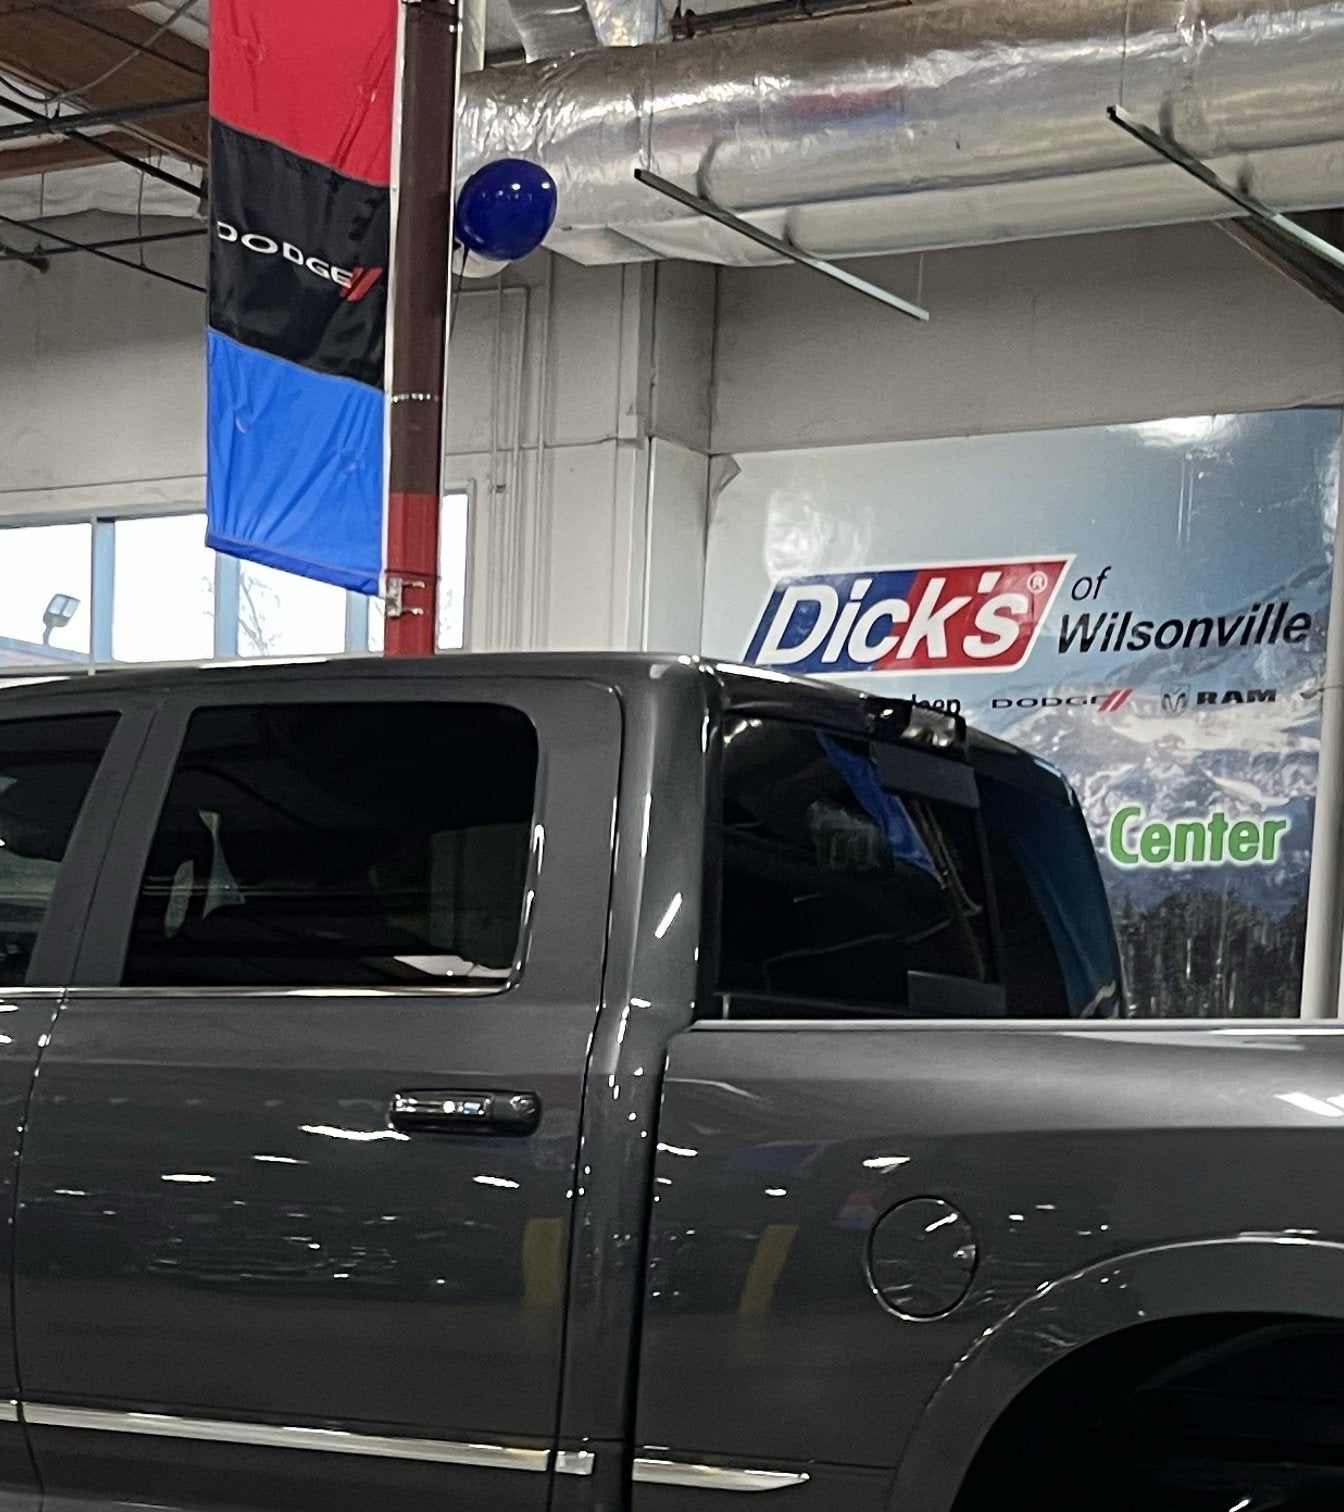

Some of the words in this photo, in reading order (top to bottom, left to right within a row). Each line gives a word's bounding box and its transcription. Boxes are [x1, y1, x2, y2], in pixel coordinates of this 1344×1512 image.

[217, 221, 353, 288] DODGE
[756, 572, 1029, 665] Dick's
[1071, 566, 1111, 600] of
[1058, 601, 1311, 653] Wilsonville
[1197, 690, 1276, 704] RAM
[1110, 807, 1286, 863] Center
